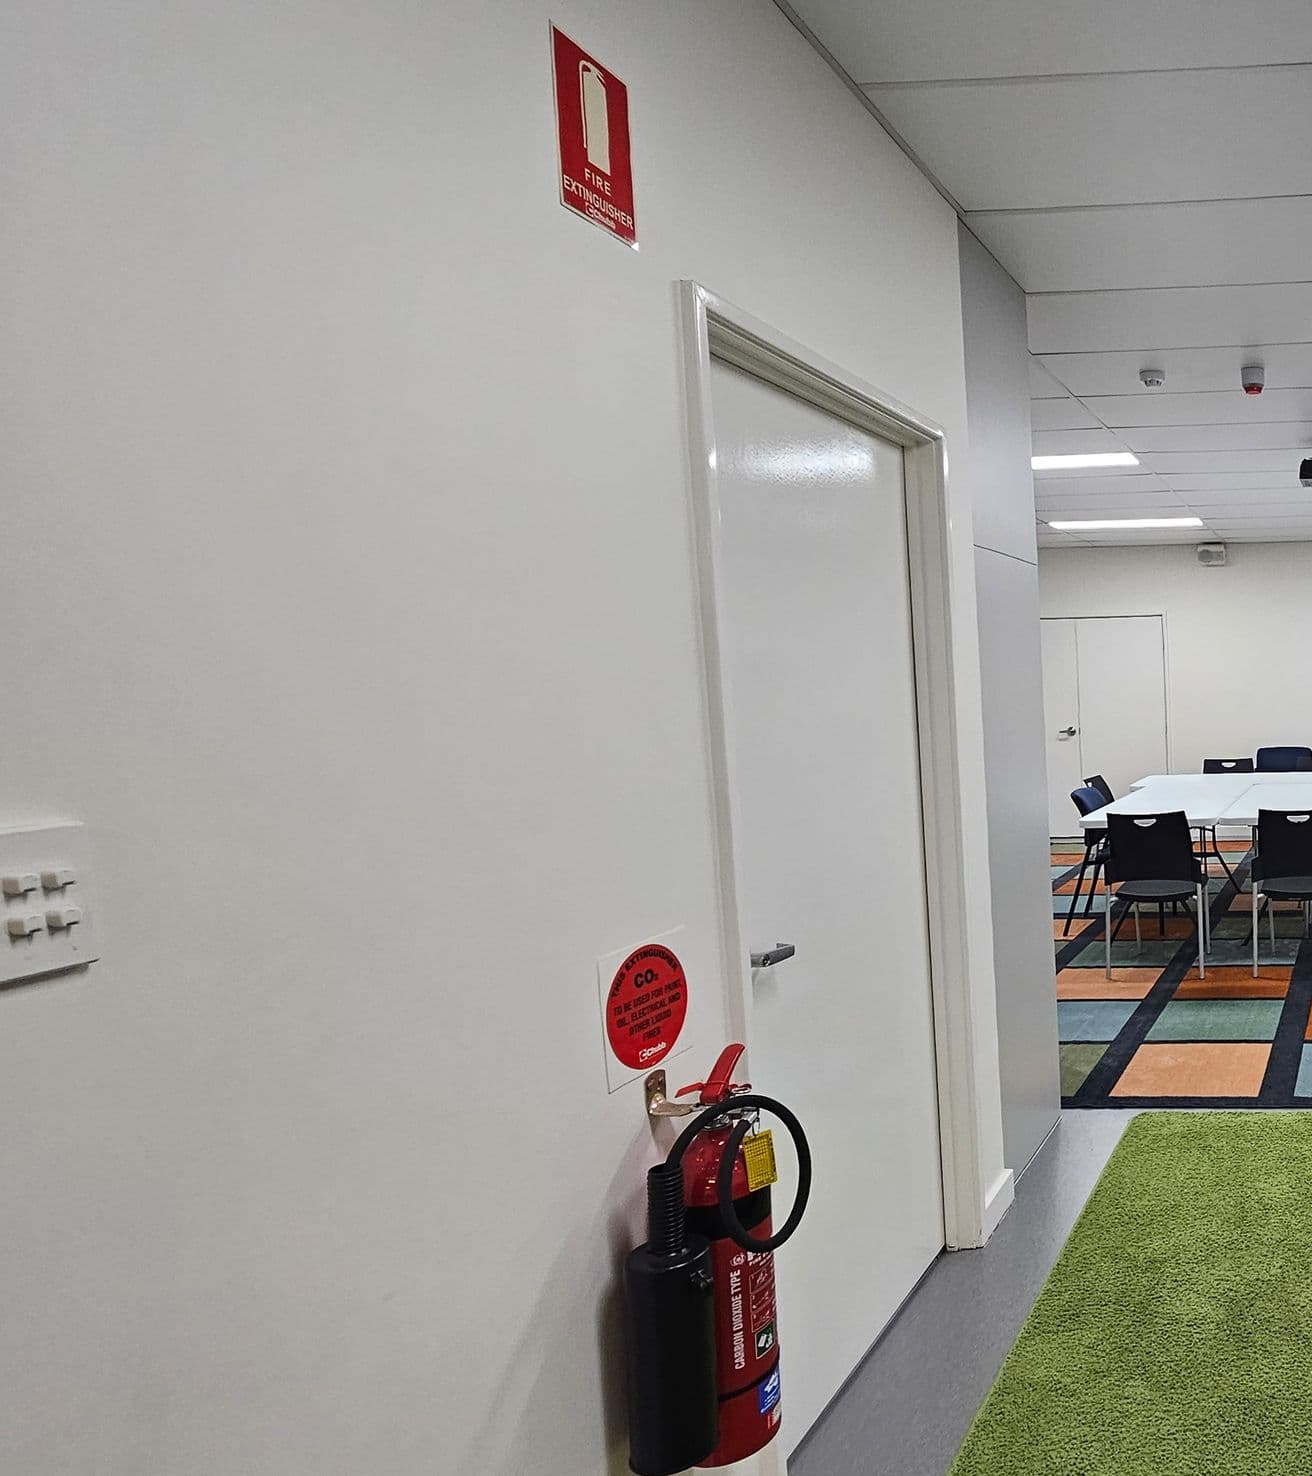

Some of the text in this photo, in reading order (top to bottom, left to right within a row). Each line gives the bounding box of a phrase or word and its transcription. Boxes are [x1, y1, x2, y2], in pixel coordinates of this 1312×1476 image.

[563, 174, 634, 230] EXTINGUISHER
[584, 168, 611, 196] FIRE
[633, 993, 650, 1008] USED
[651, 987, 663, 999] FOR
[730, 1269, 746, 1370] CARBON DIOXIDE TYPE
